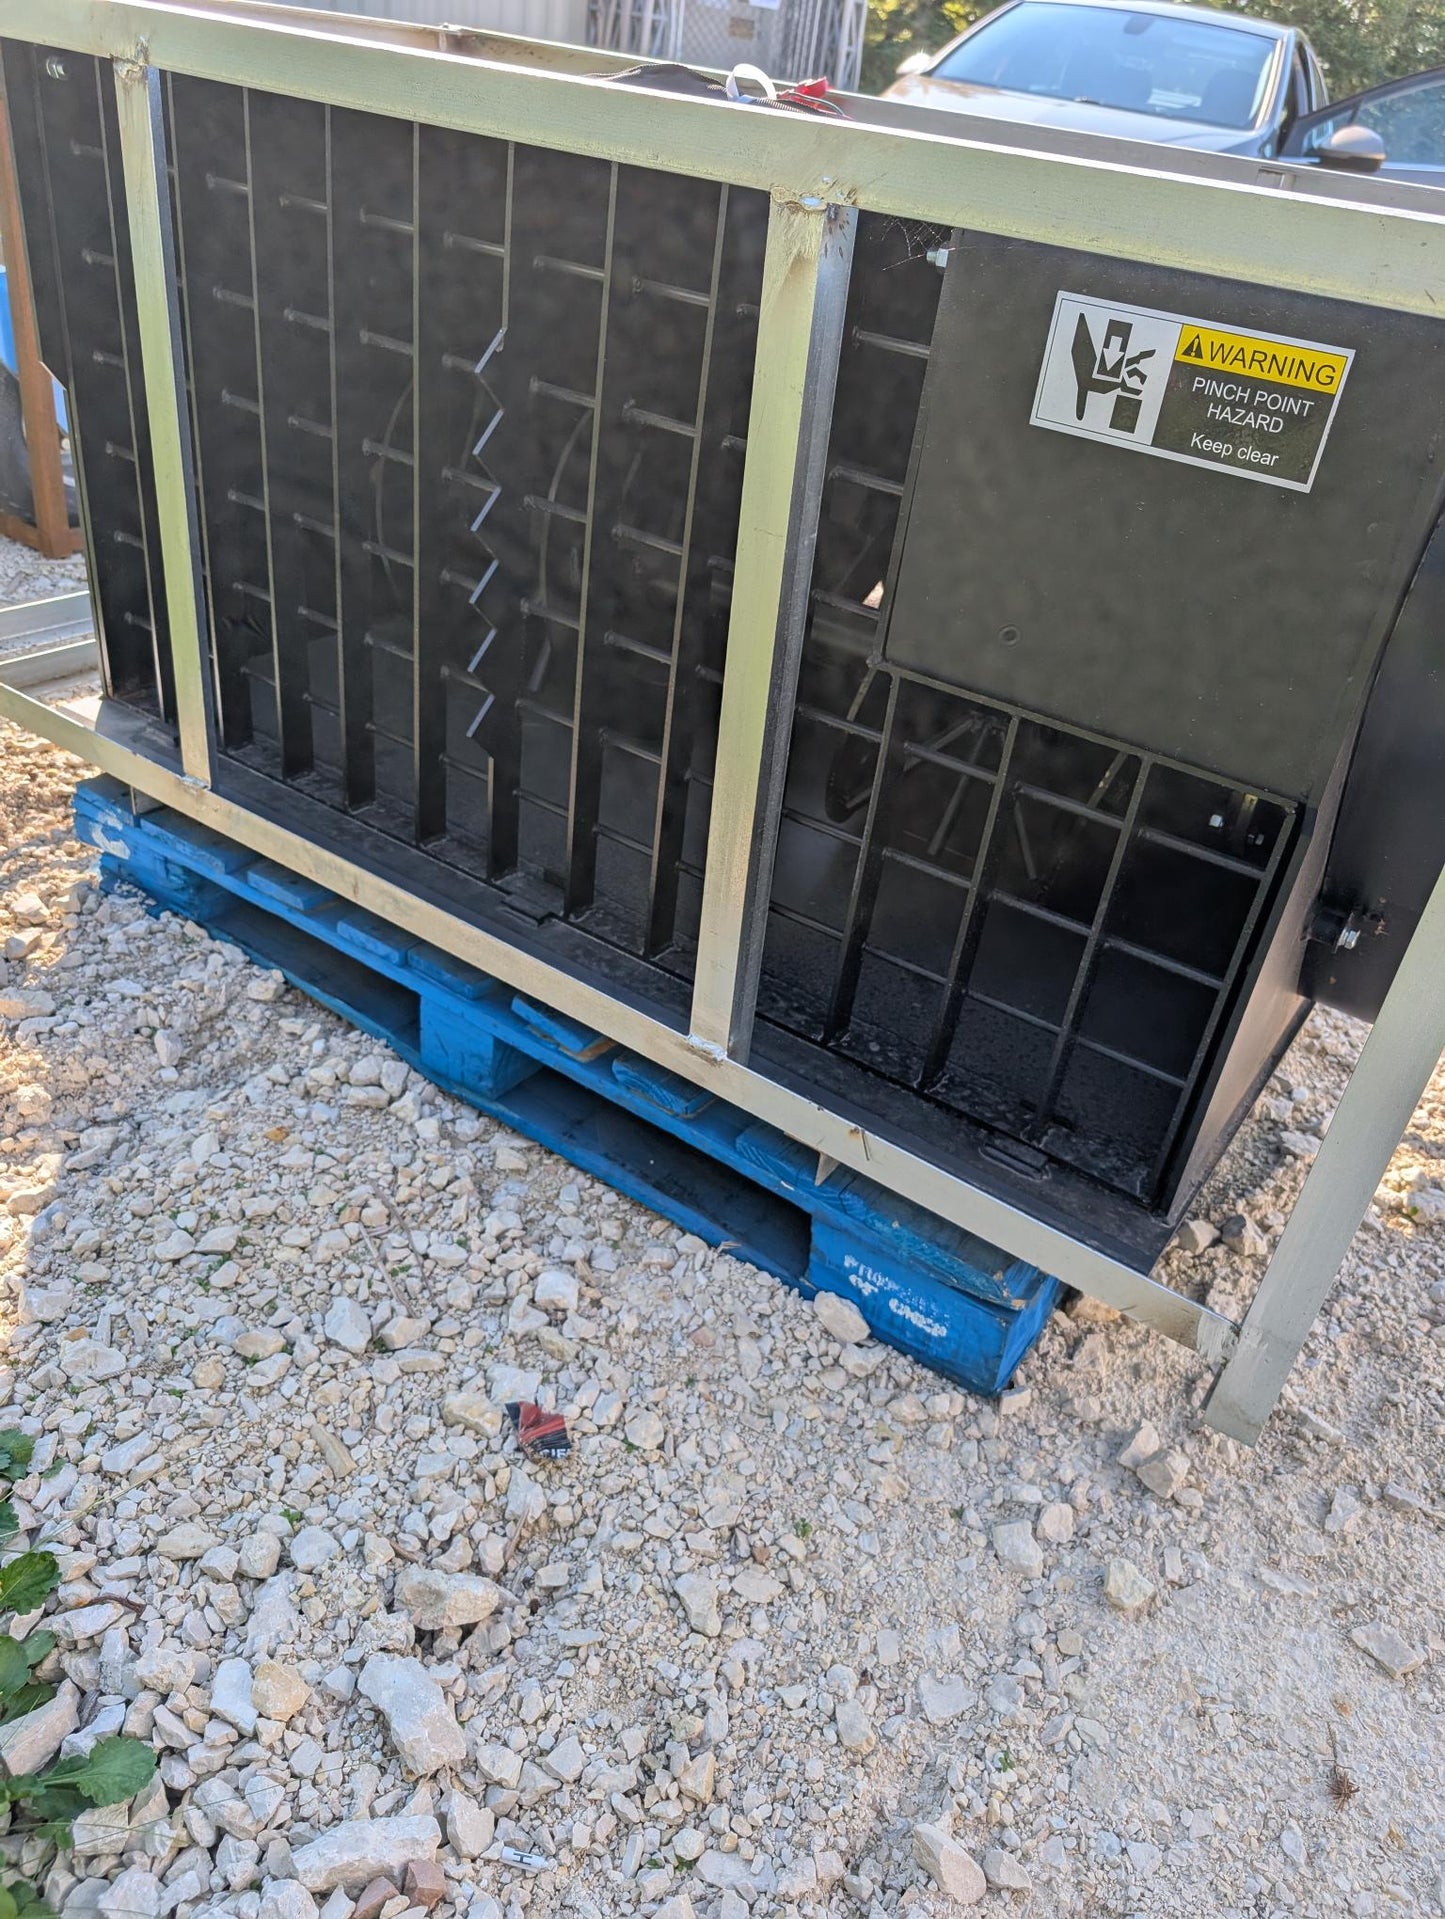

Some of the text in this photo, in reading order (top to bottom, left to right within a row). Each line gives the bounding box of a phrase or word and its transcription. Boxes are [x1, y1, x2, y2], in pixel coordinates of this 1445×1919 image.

[1209, 341, 1336, 386] WARNING
[1193, 378, 1314, 417] PINCH POINT
[1207, 402, 1284, 433] HAZARD
[1190, 433, 1279, 467] Keep clear
